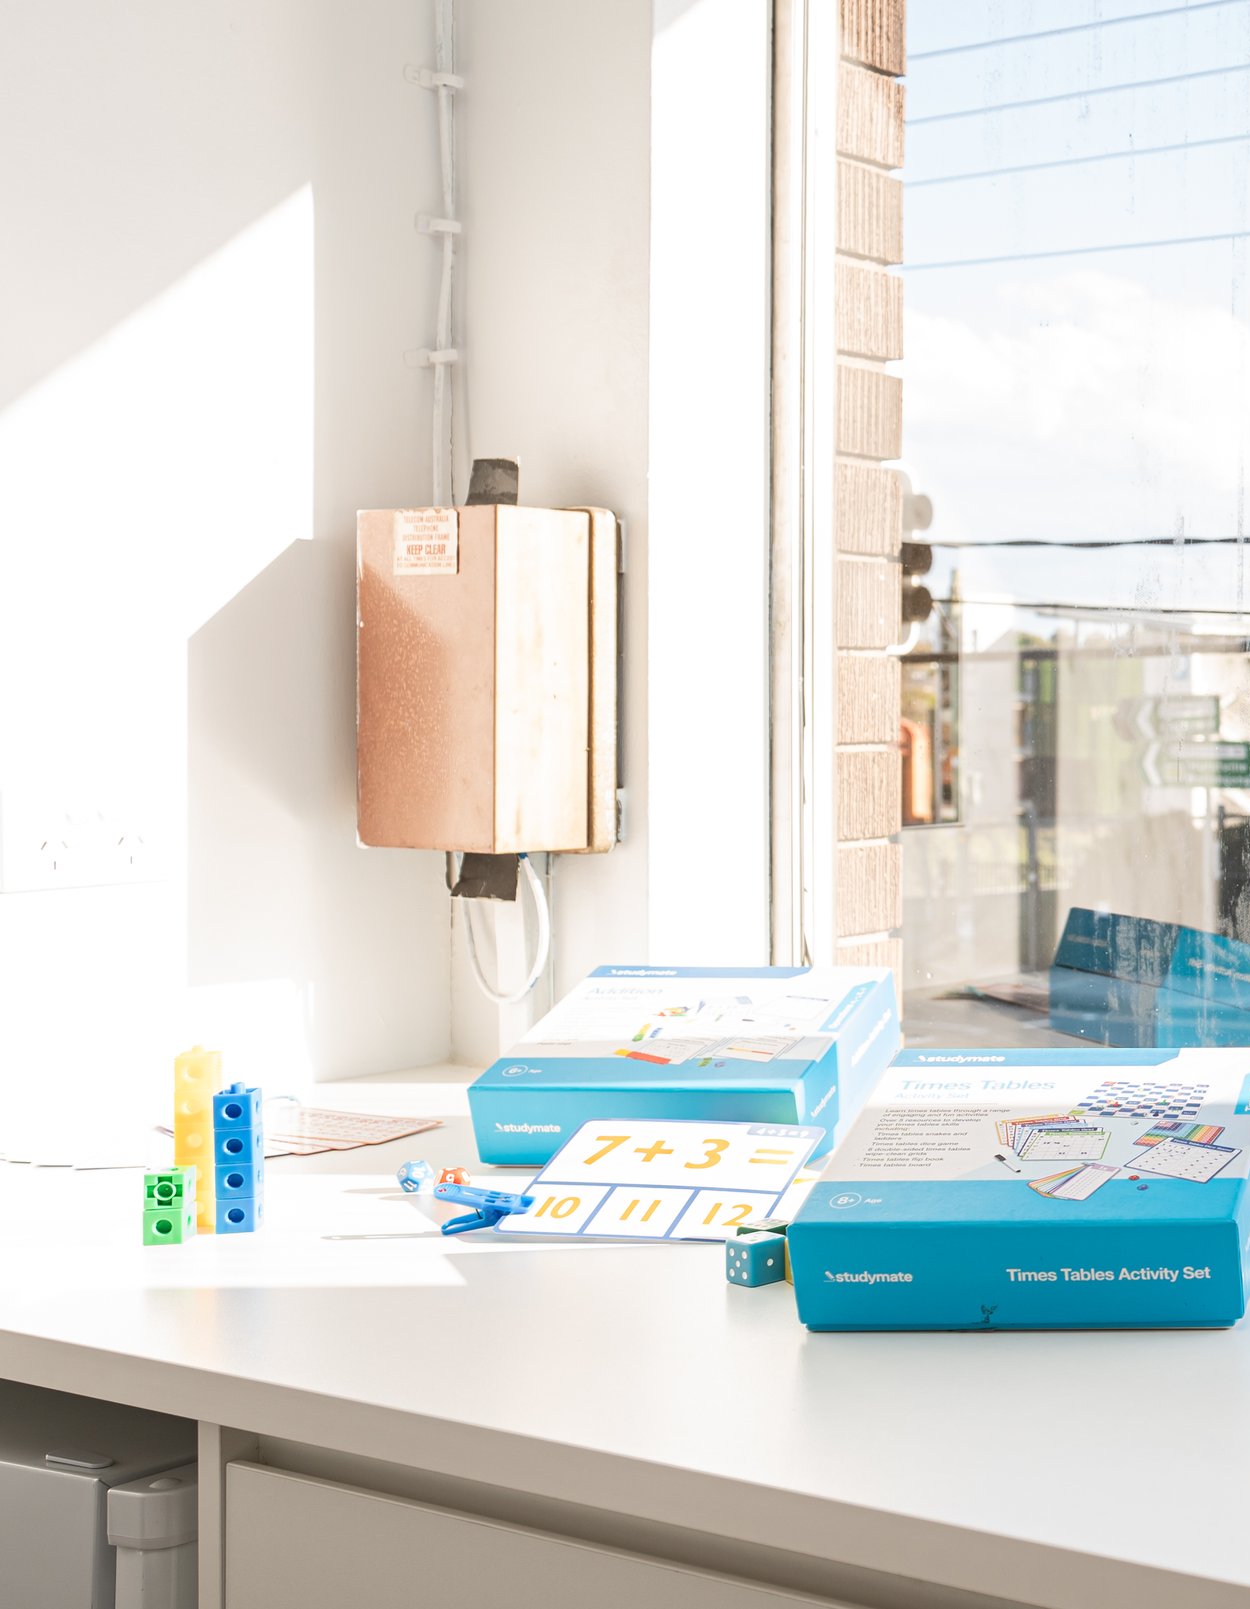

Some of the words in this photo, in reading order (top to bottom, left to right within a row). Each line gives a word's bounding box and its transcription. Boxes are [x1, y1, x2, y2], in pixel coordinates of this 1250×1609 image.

[406, 544, 423, 555] KEEP
[425, 544, 446, 555] CLEAR
[616, 969, 677, 977] studymate
[927, 1056, 1005, 1064] studymate
[902, 1080, 971, 1090] Times
[982, 1080, 1057, 1090] Tables
[504, 1123, 561, 1134] studymate
[583, 1135, 631, 1165] 7
[633, 1140, 675, 1162] +
[684, 1138, 730, 1169] 3
[748, 1149, 795, 1165] =
[837, 1196, 854, 1205] 8+
[534, 1196, 581, 1219] 10
[619, 1199, 662, 1222] 11
[702, 1202, 753, 1227] 12
[836, 1271, 913, 1285] studymate
[1006, 1268, 1057, 1282] Times
[1060, 1268, 1115, 1281] Tables
[1118, 1267, 1179, 1283] Activity
[1182, 1266, 1211, 1280] Set
